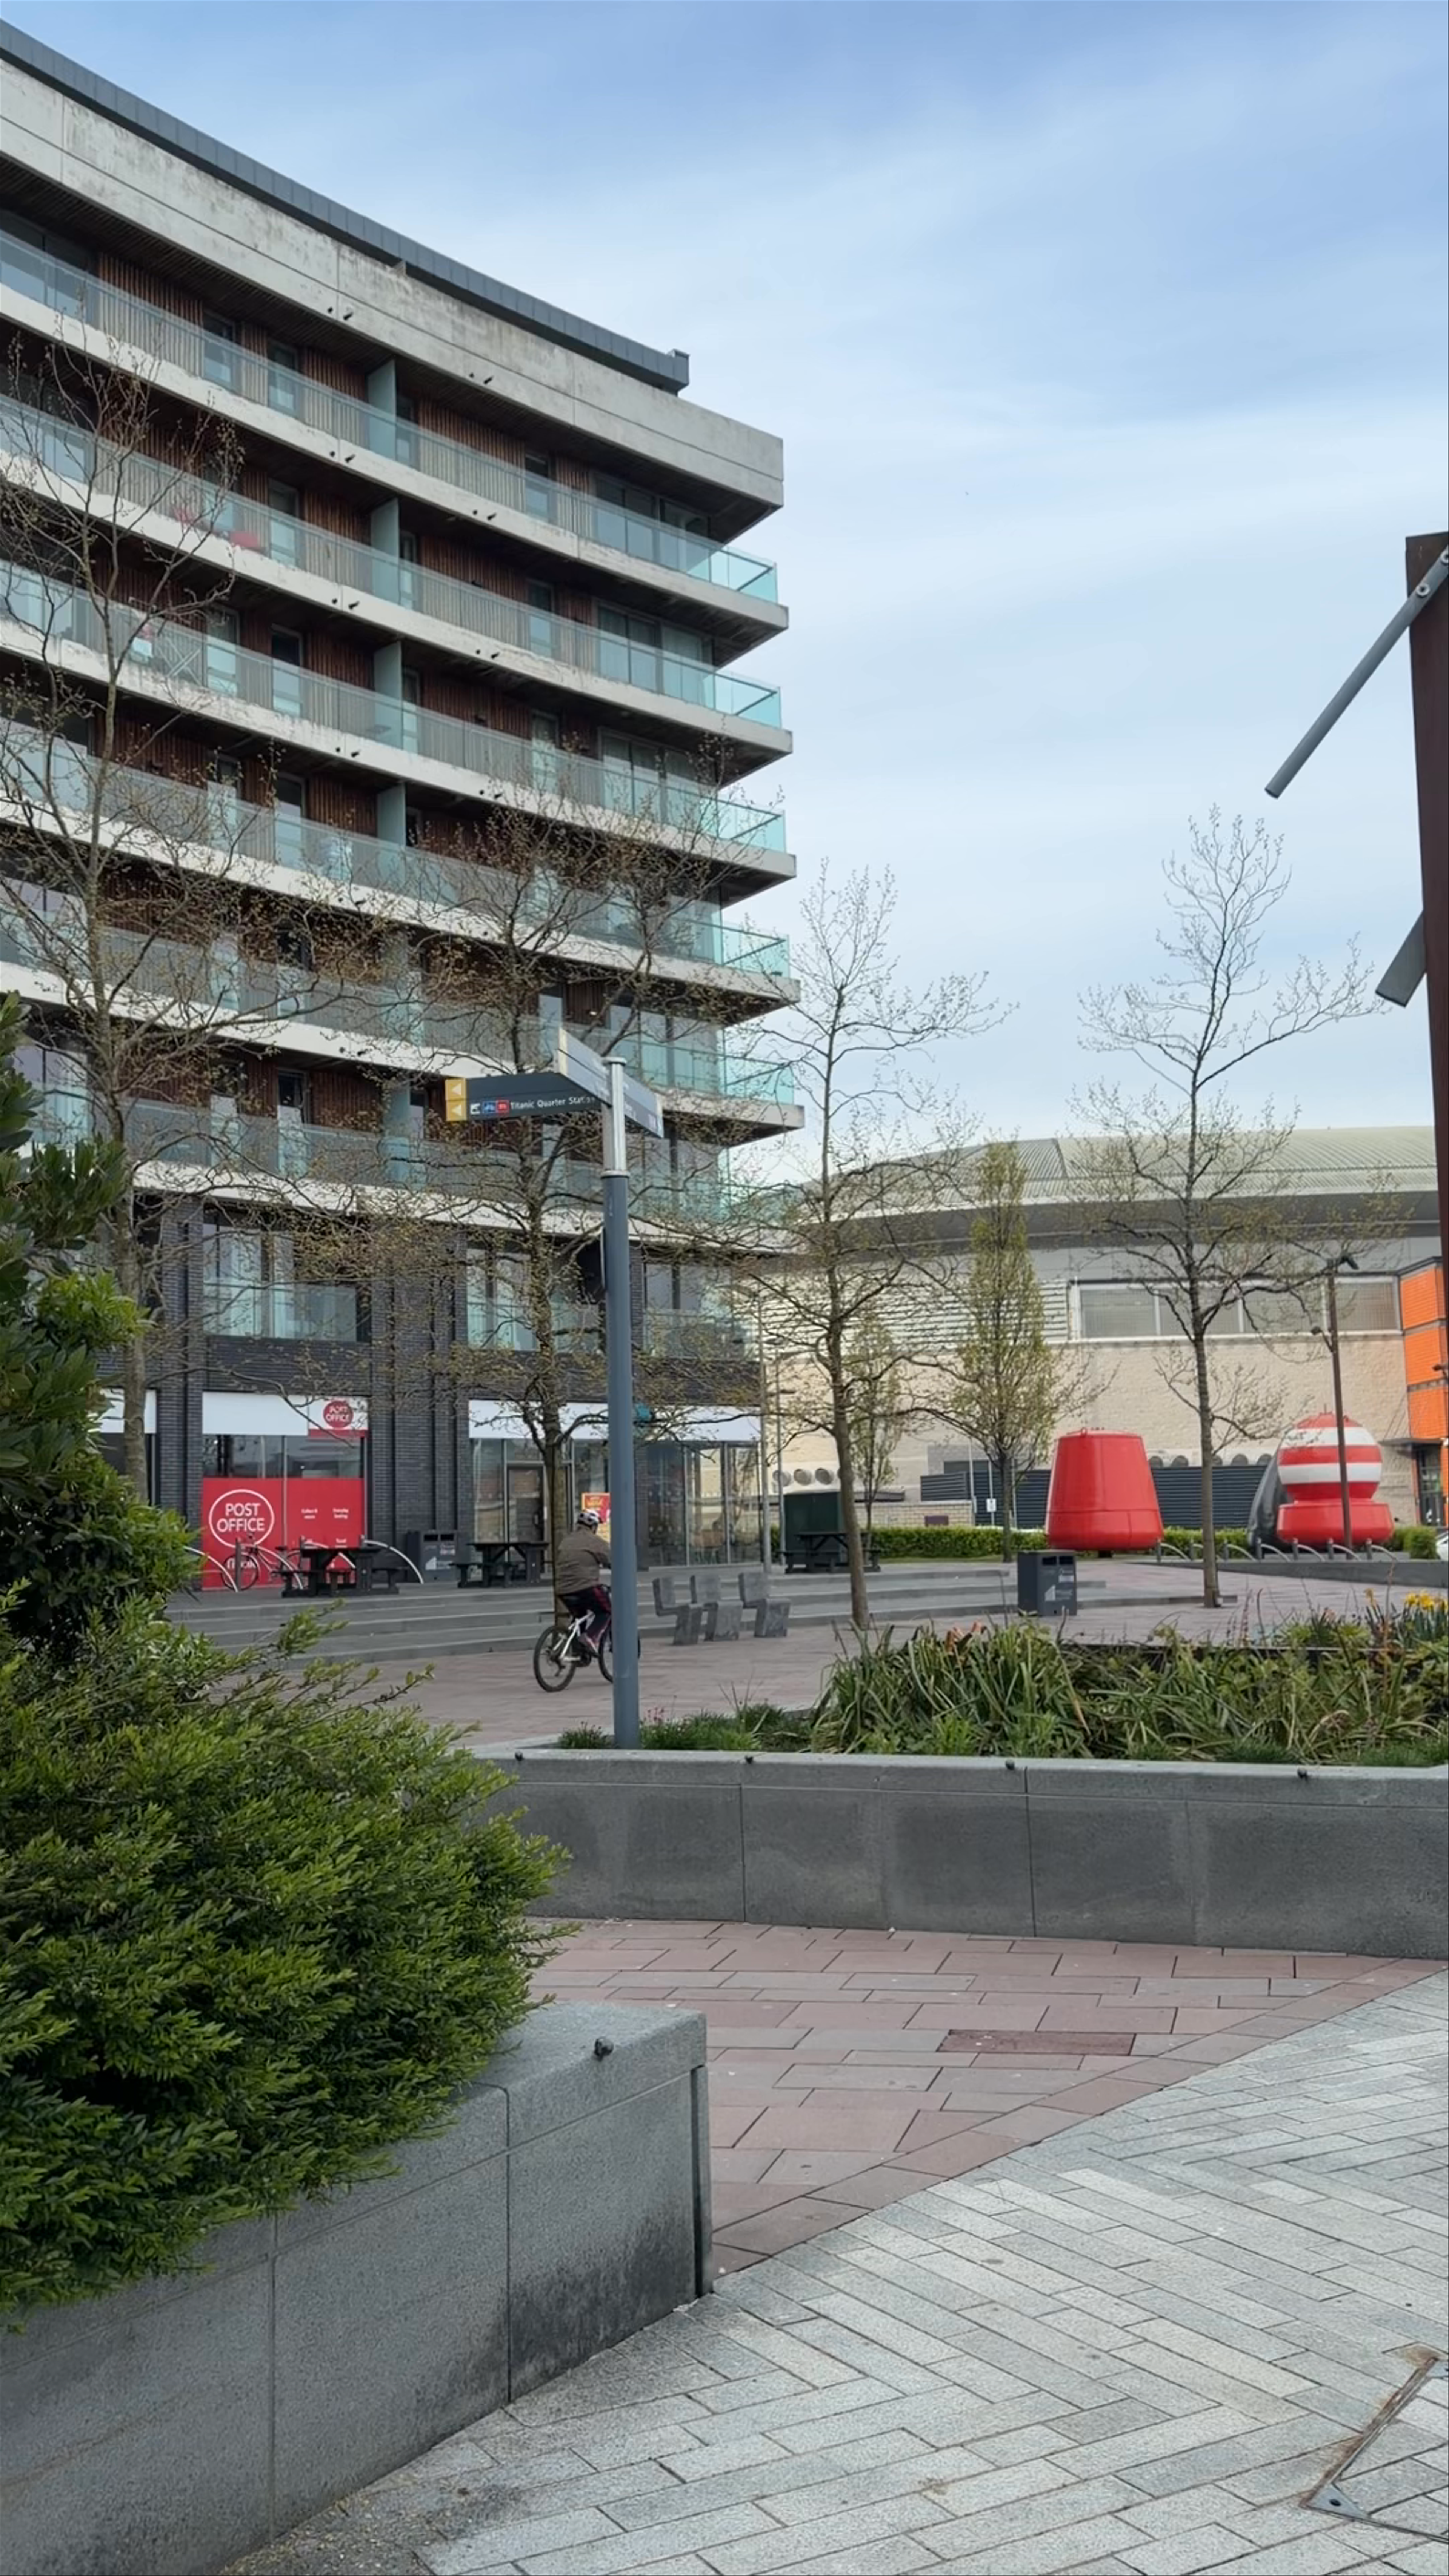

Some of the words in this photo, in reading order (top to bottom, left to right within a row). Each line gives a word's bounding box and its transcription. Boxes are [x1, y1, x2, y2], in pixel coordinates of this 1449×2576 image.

[511, 1100, 534, 1109] Titanic
[537, 1098, 566, 1107] Quarter
[326, 1413, 349, 1422] OFFICE
[225, 1503, 261, 1516] POST
[217, 1518, 265, 1532] OFFICE
